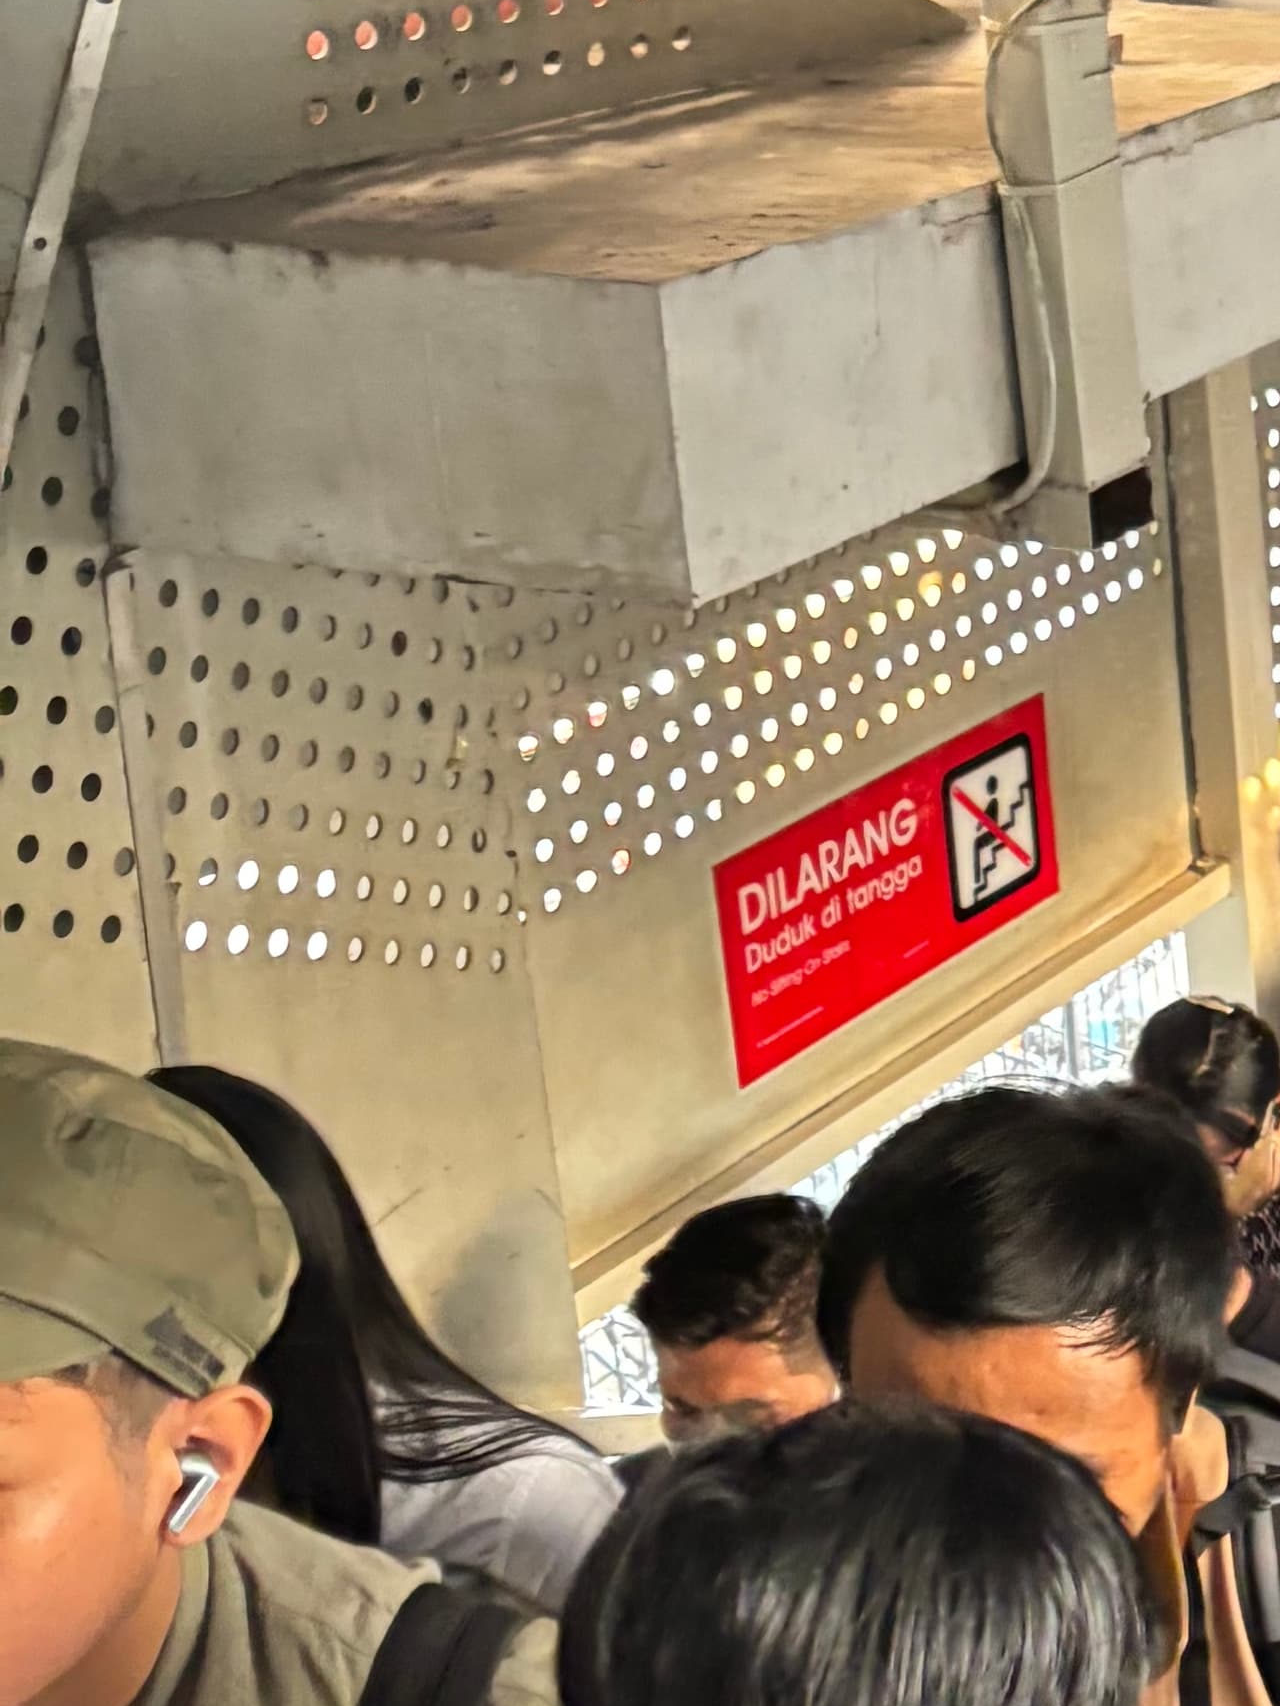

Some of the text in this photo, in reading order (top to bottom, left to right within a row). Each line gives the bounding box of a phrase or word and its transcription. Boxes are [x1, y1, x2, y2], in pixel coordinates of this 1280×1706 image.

[737, 797, 918, 936] DILARANG
[744, 854, 923, 974] Duduk di tangga
